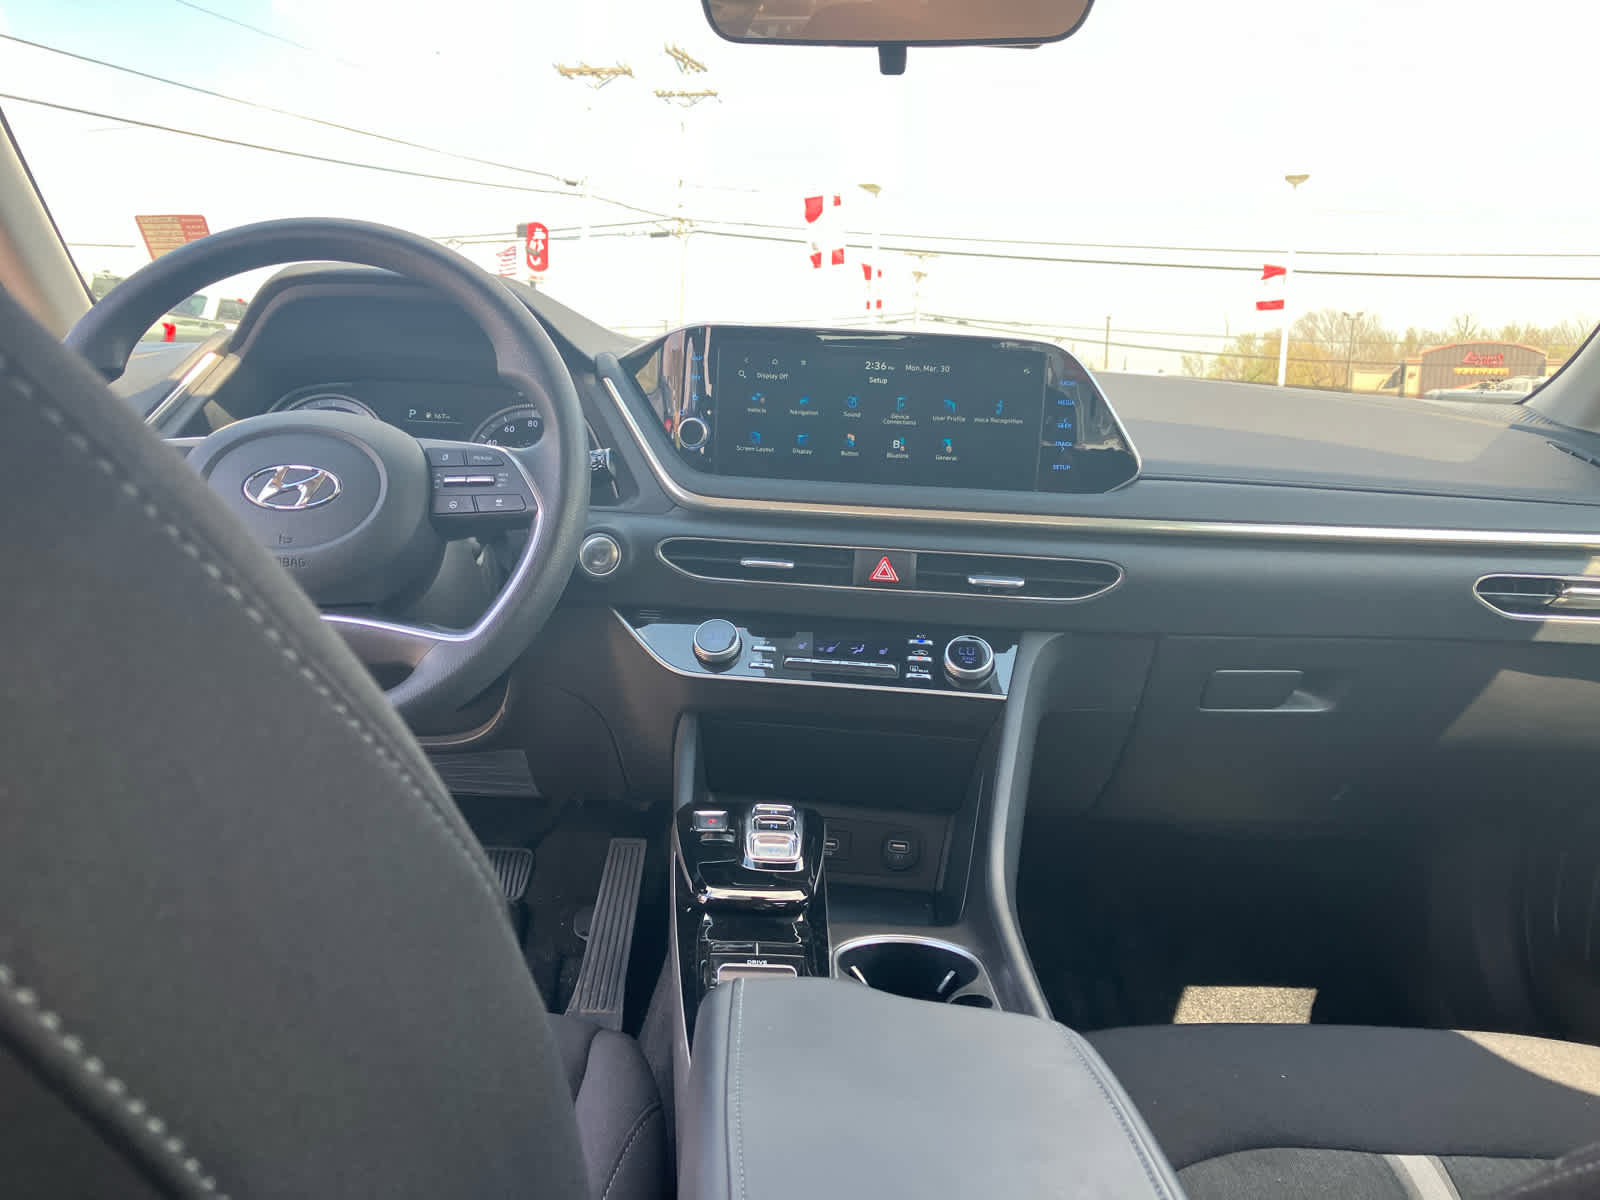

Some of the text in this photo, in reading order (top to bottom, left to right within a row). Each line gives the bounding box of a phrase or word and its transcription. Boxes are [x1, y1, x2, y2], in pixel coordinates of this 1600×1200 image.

[865, 361, 887, 370] 2:36
[941, 365, 950, 373] 30
[757, 372, 789, 380] Display Off
[869, 376, 888, 384] Setup
[408, 408, 417, 418] P
[527, 419, 538, 428] 80
[504, 425, 515, 433] 60
[792, 448, 813, 456] Display
[747, 959, 767, 967] DRIVE
